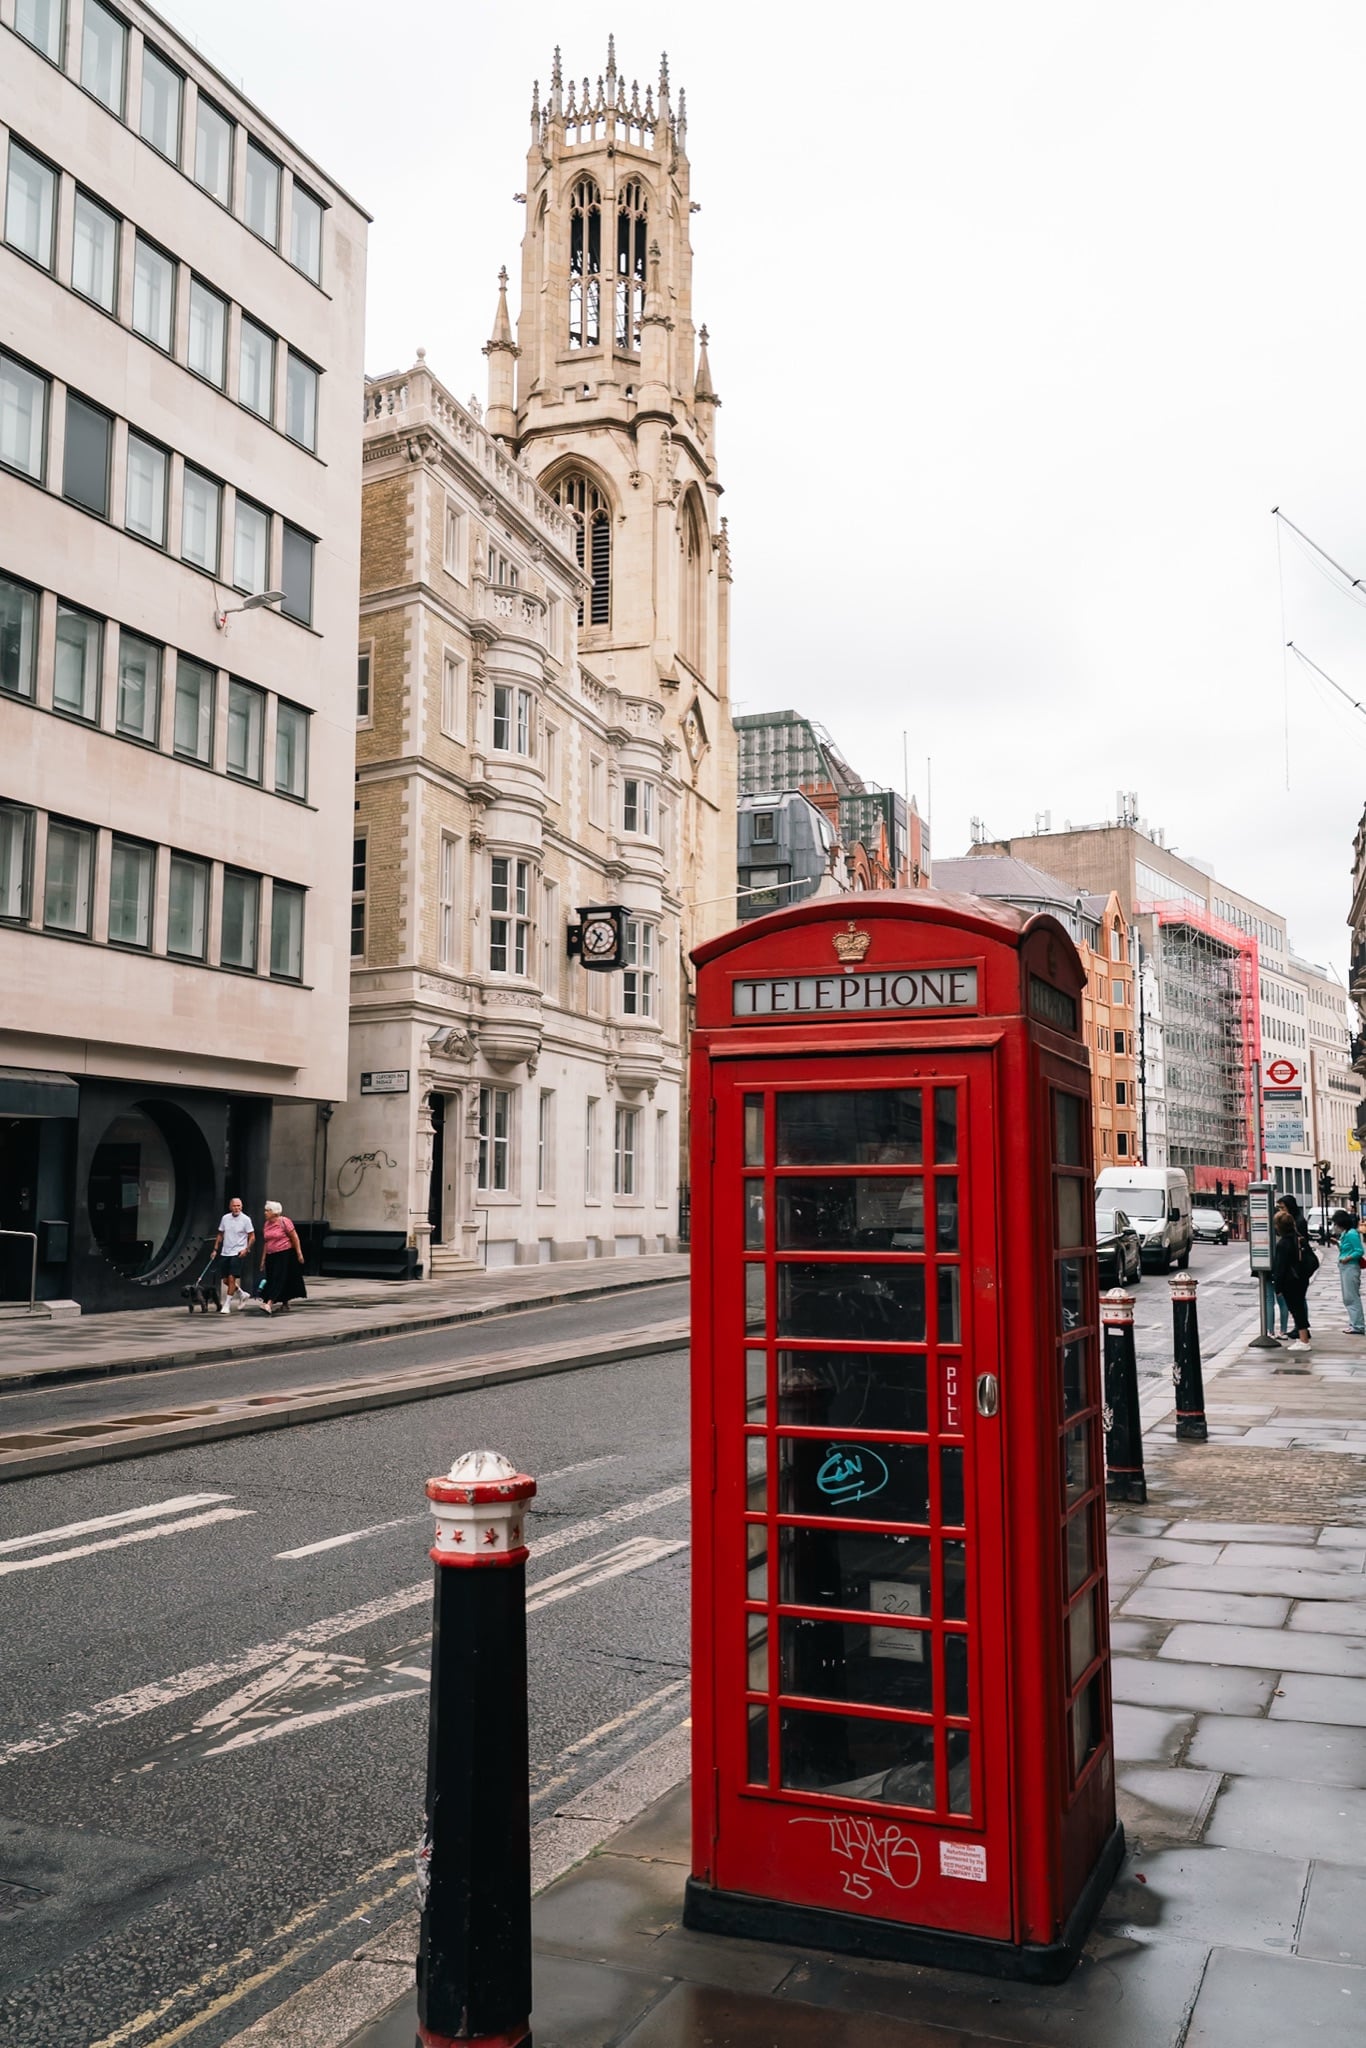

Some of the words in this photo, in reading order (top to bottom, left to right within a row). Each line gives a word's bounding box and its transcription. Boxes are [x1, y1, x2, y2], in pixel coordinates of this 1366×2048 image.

[742, 972, 968, 1012] TELEPHONE
[946, 1366, 958, 1426] PULL
[946, 1868, 971, 1876] COMPANY
[954, 1863, 972, 1871] PHONE
[839, 1870, 873, 1900] 25
